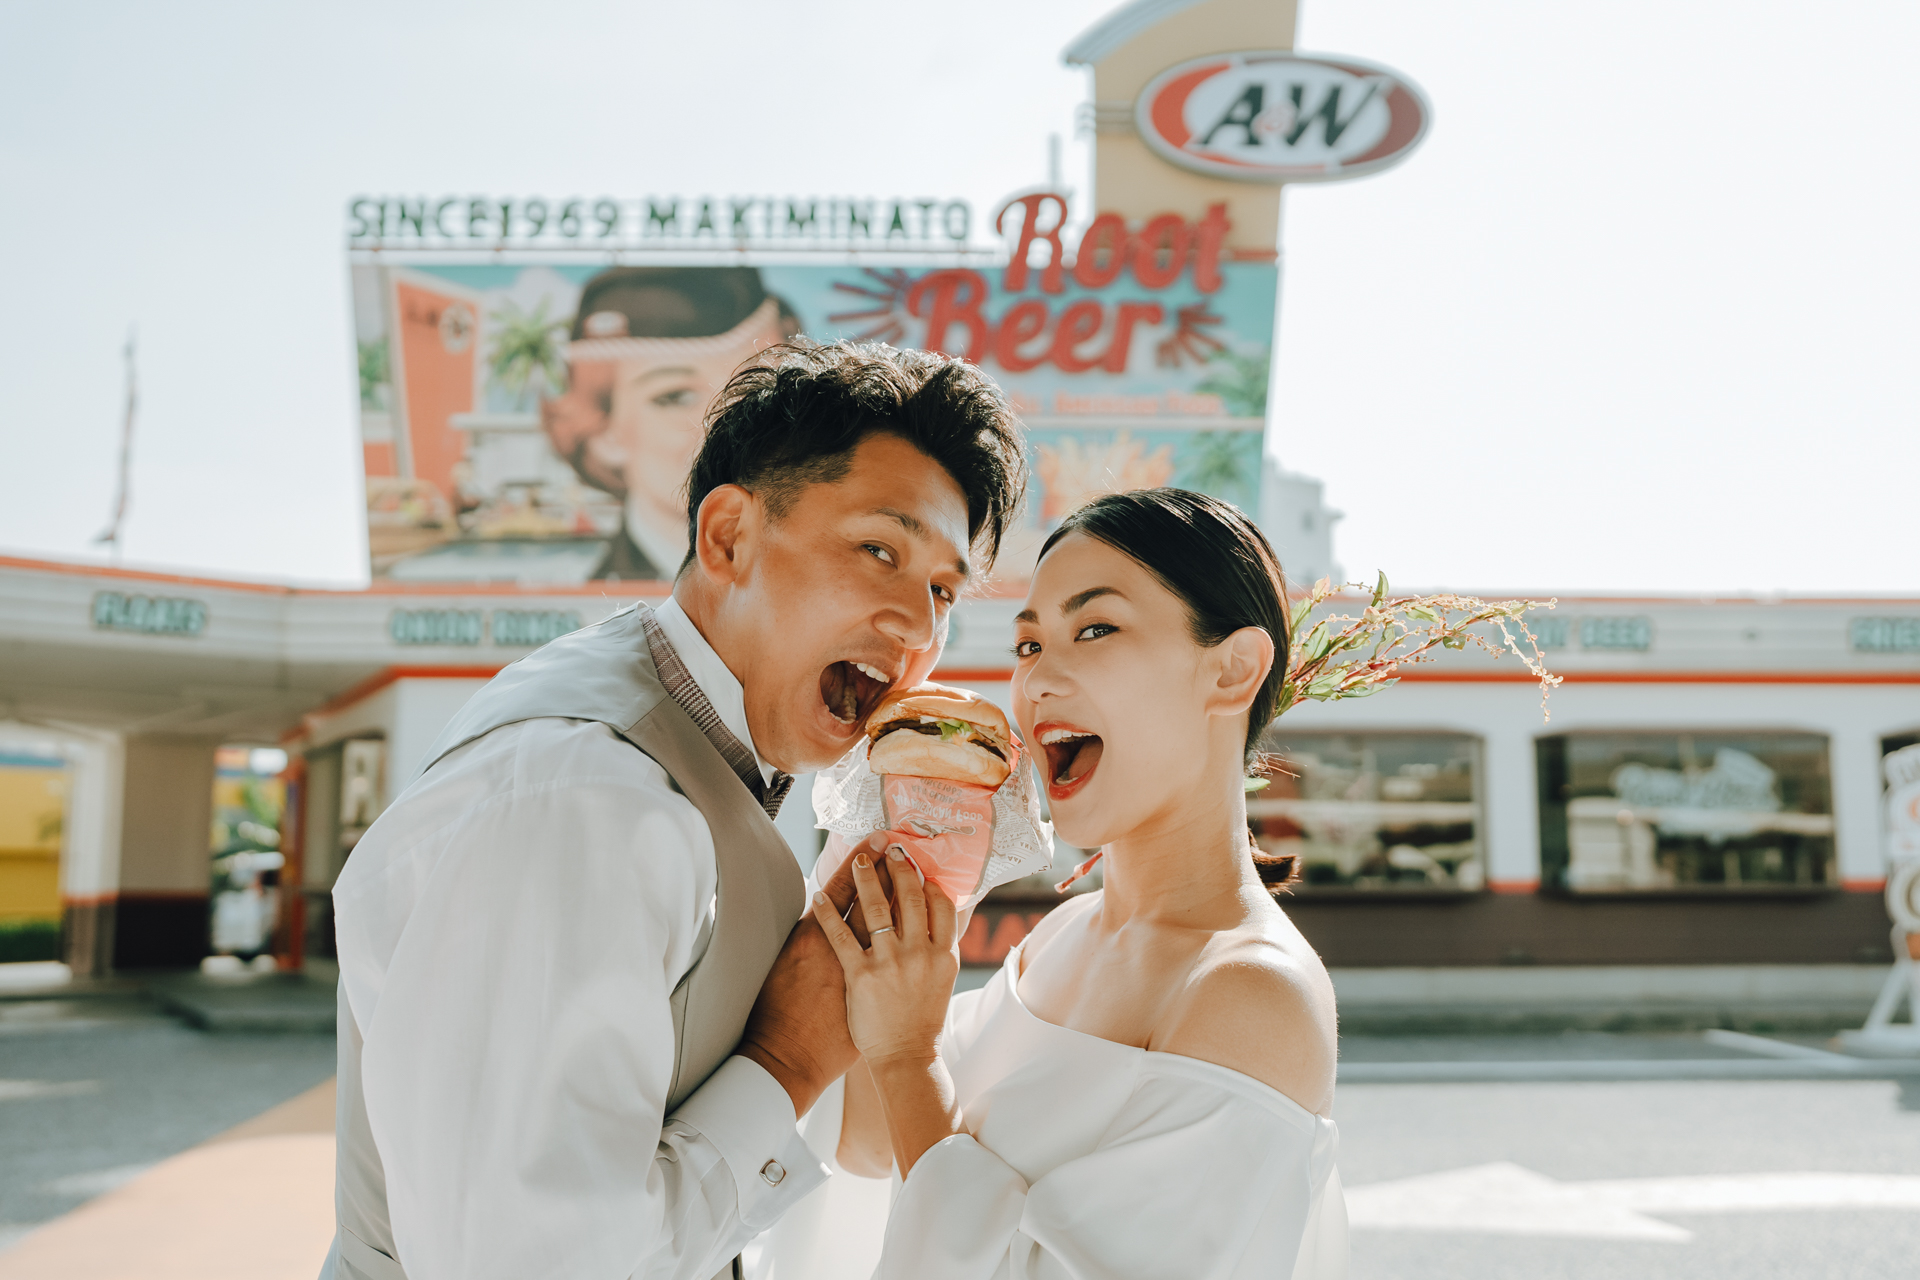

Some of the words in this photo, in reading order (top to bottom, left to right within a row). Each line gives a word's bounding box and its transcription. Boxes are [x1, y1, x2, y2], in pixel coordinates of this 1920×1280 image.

[1196, 79, 1382, 149] A&W
[647, 197, 971, 240] MAKIMINATO
[995, 186, 1234, 295] Root
[906, 267, 1166, 374] Beer
